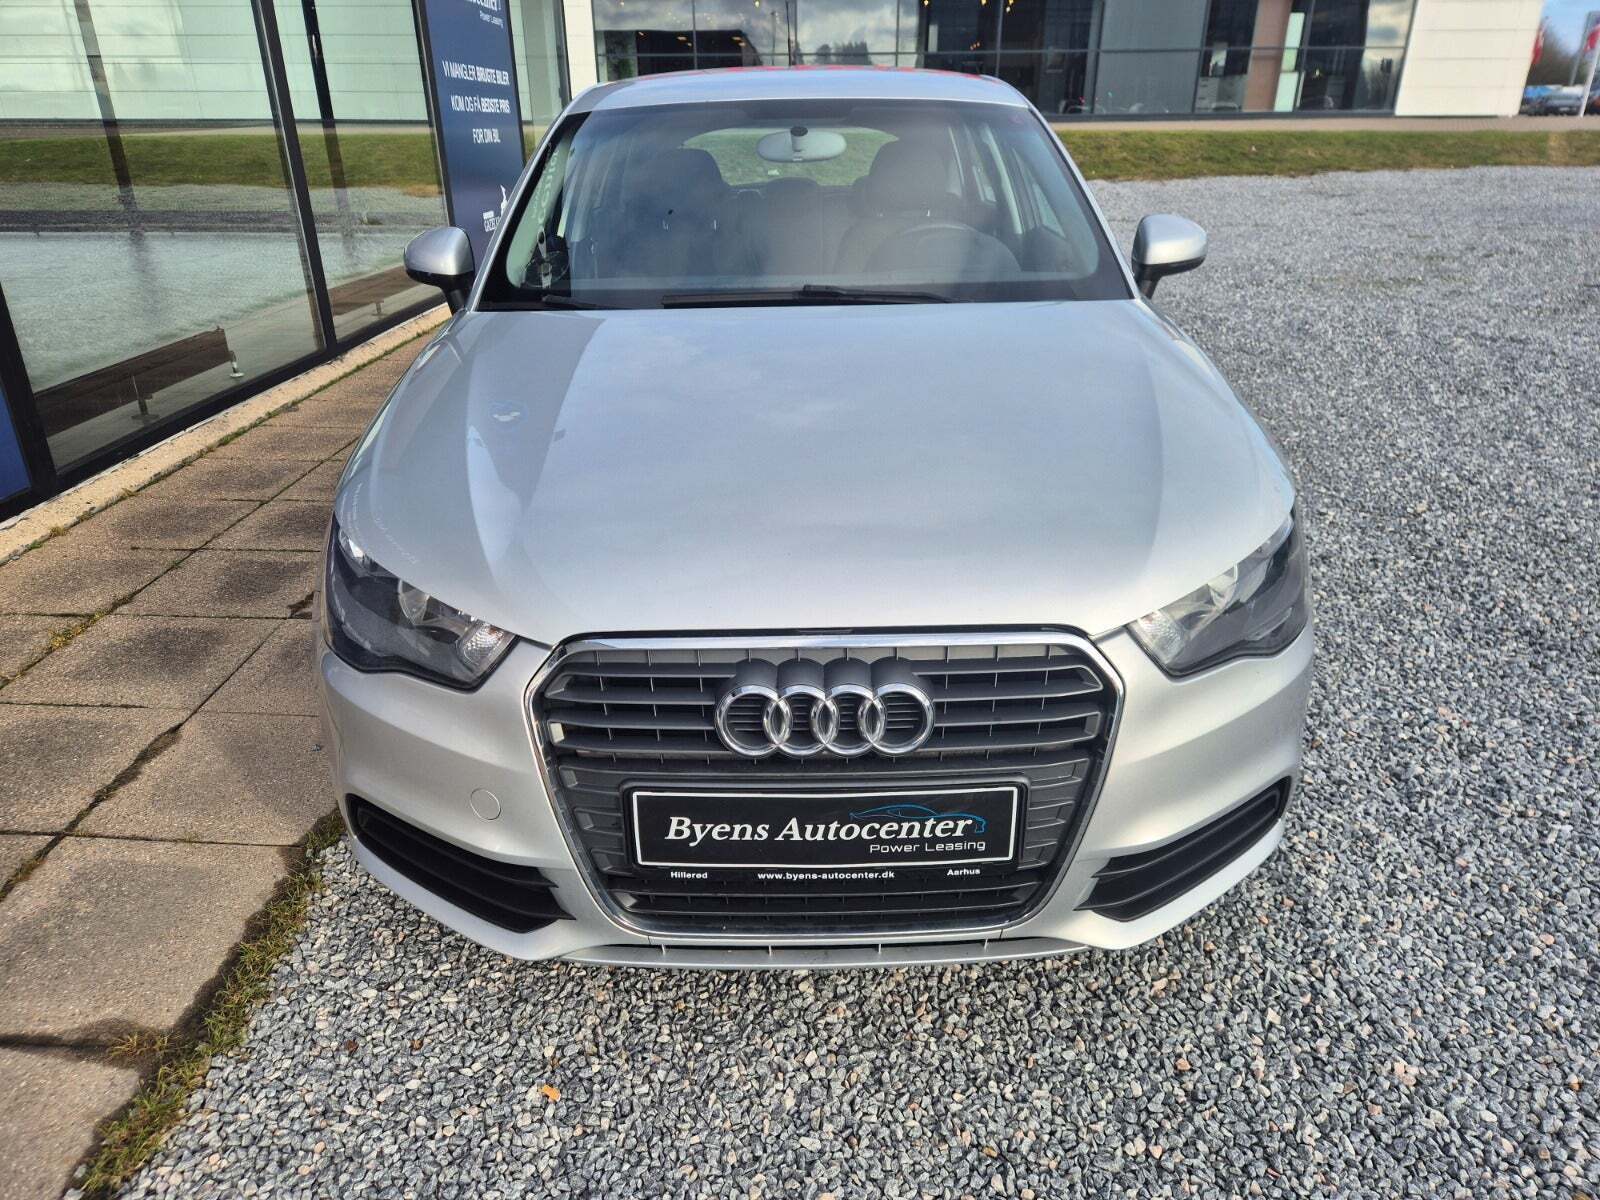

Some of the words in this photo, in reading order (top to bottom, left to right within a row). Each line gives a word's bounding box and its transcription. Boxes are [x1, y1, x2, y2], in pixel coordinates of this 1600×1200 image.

[449, 61, 476, 81] MANGLER
[451, 95, 465, 112] KOM
[464, 96, 474, 112] OG
[472, 128, 484, 144] FOR
[664, 816, 769, 847] Byens
[774, 817, 973, 842] Autocenter
[870, 843, 920, 853] Power
[925, 840, 986, 852] Leasing
[757, 870, 895, 881] www.byens-autocenter.dk
[947, 868, 981, 877] Aarhus
